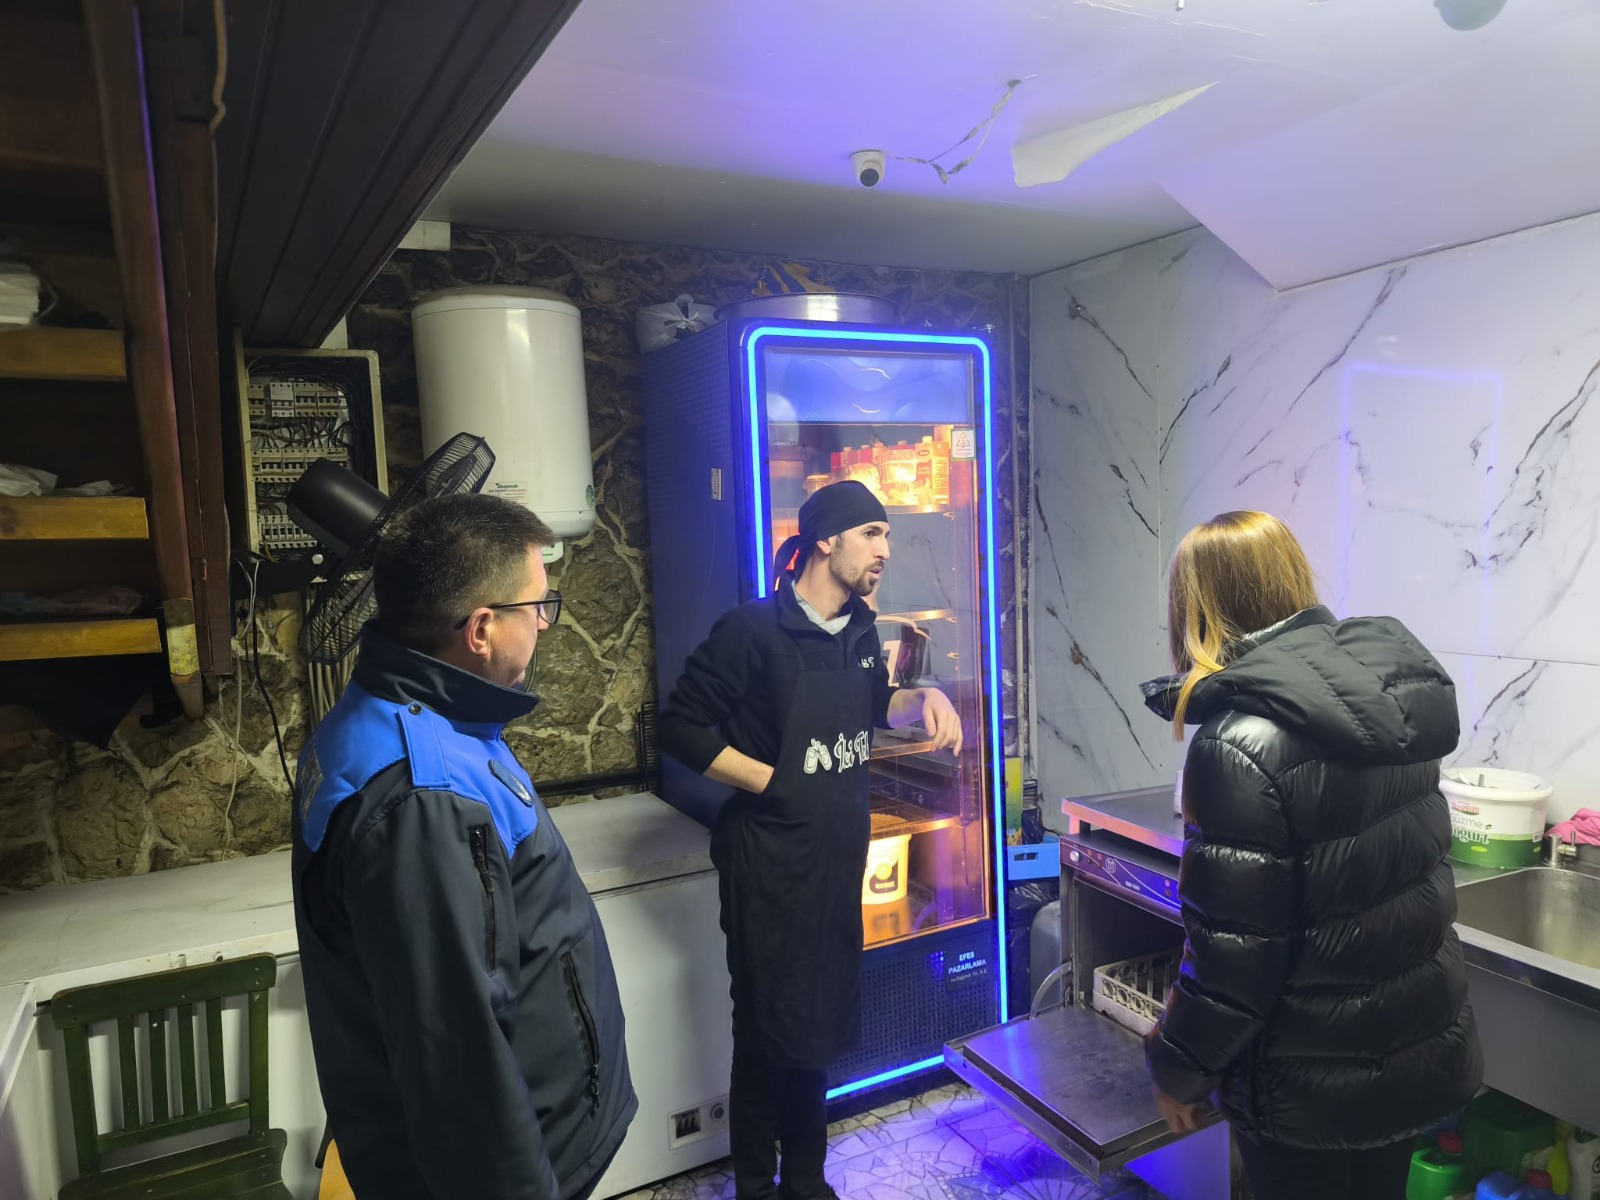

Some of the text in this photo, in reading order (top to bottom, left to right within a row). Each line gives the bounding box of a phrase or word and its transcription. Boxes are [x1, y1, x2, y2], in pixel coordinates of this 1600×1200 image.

[1453, 826, 1489, 844] oğurt
[959, 951, 975, 961] EFES
[948, 959, 987, 975] PAZARLAMA
